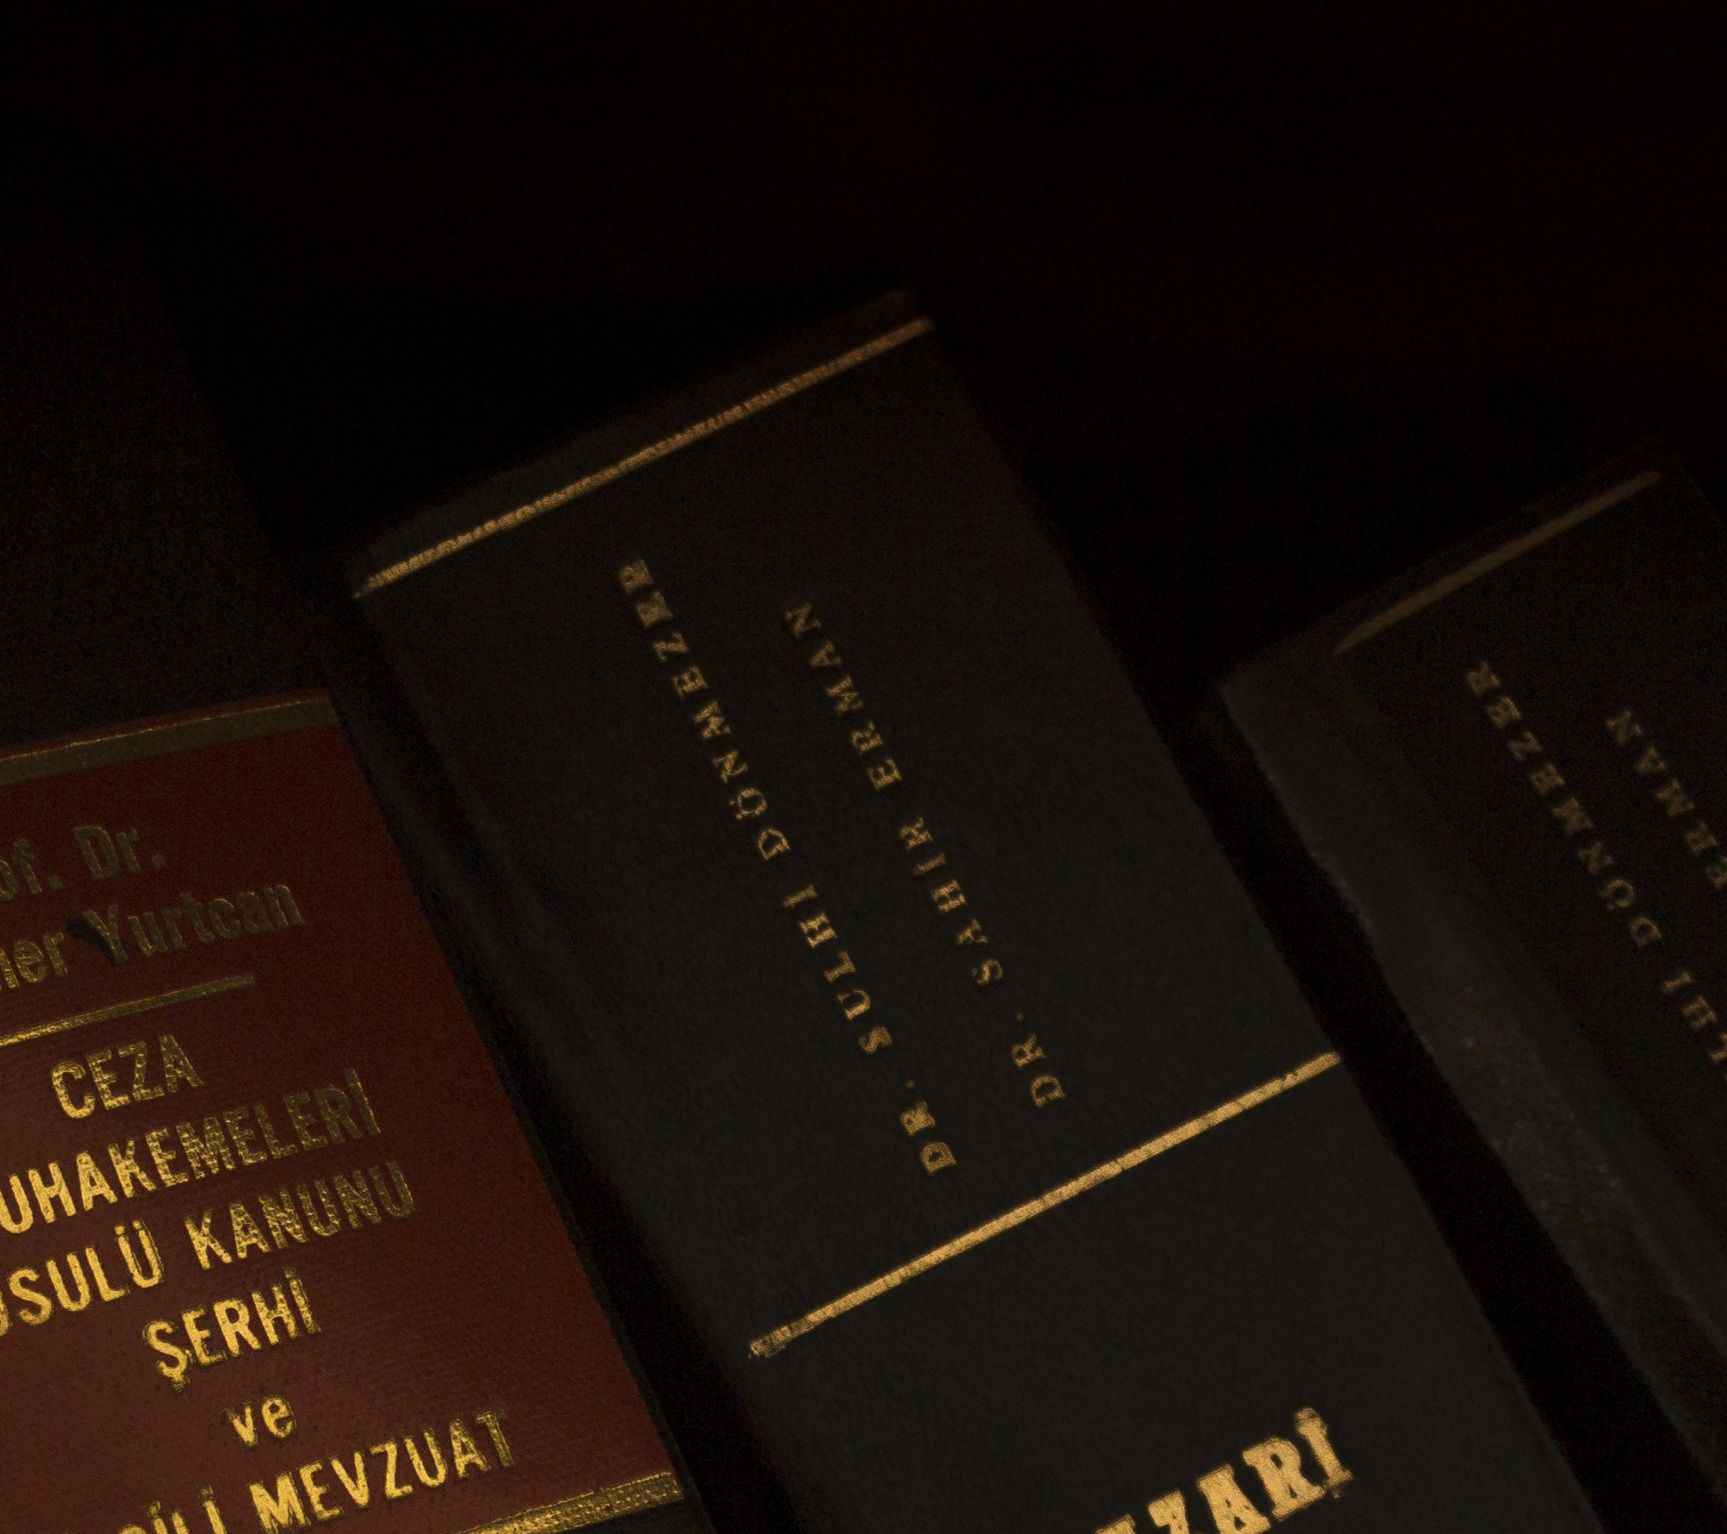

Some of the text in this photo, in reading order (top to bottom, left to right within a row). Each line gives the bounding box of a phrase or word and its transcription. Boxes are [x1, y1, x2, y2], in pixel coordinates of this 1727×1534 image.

[784, 601, 902, 791] ERMAN
[73, 824, 166, 881] Dr.
[83, 881, 304, 966] Yurtcan
[49, 1034, 205, 1122] CEZA
[1010, 1011, 1066, 1107] DR.
[899, 1078, 957, 1177] DR.
[186, 1159, 416, 1273] KANUNU
[143, 1268, 322, 1391] ŞERHİ
[223, 1395, 297, 1450] ve
